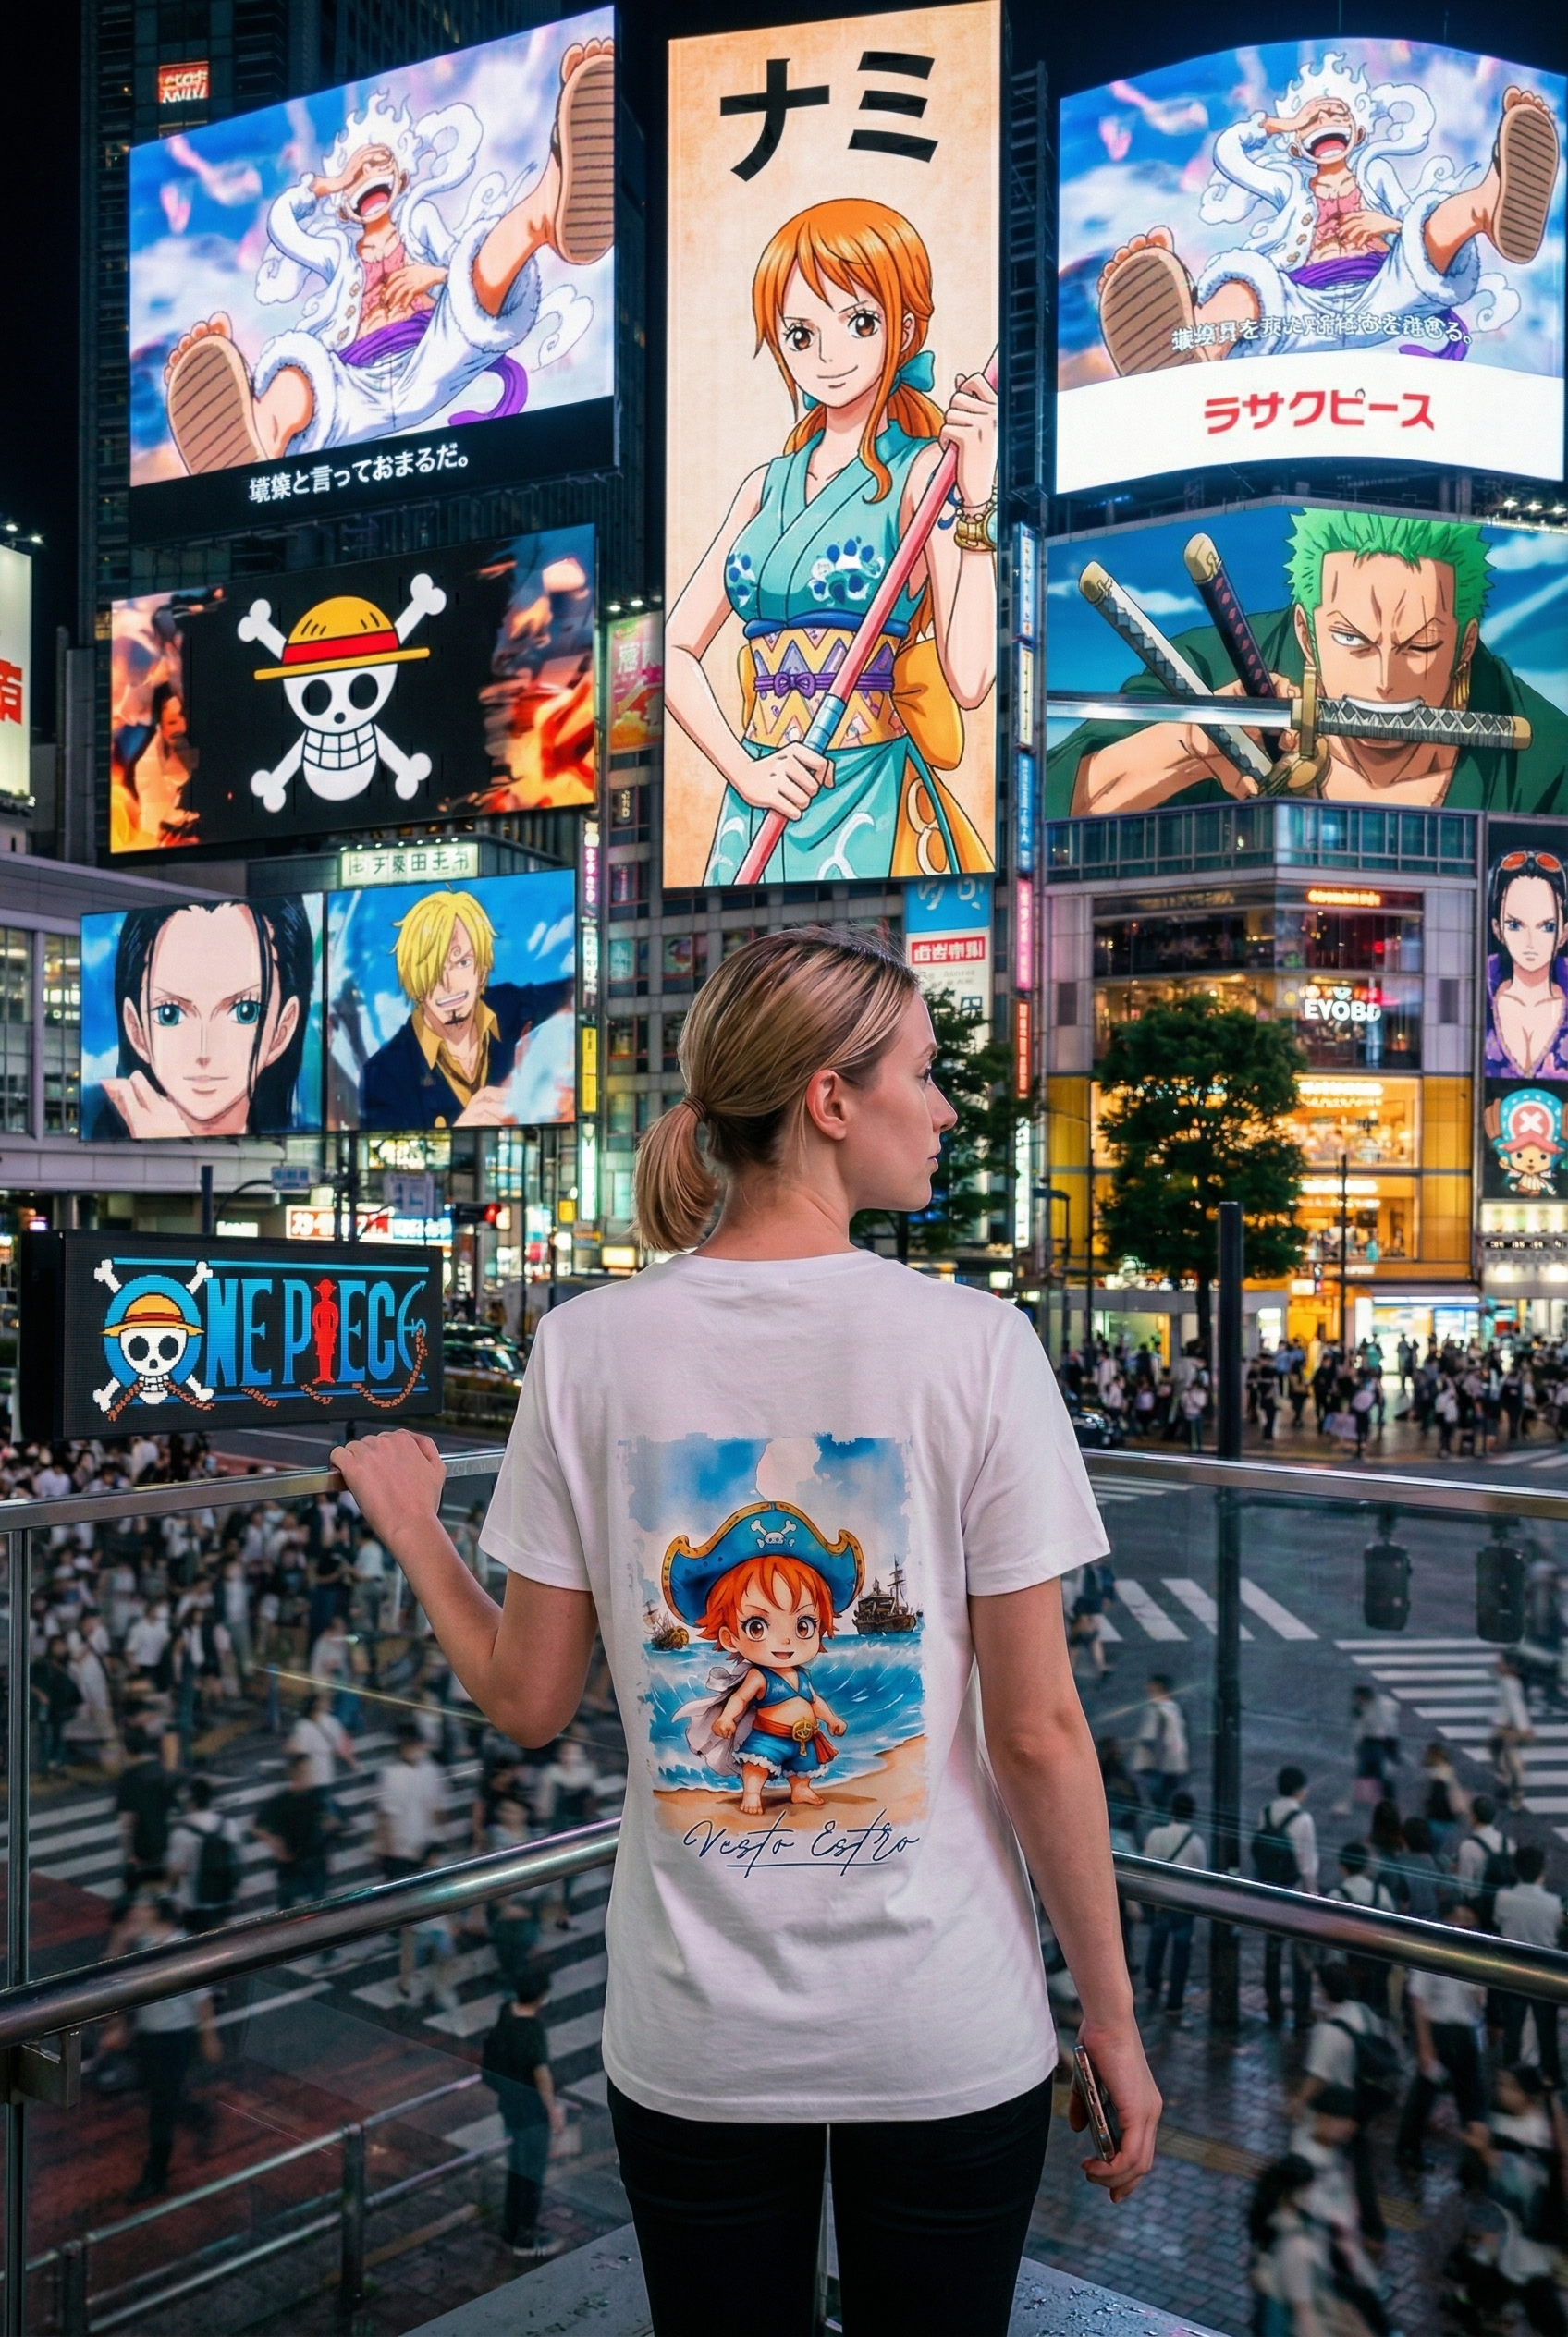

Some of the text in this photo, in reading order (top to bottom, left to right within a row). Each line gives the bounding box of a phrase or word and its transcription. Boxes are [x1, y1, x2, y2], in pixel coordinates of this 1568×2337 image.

[720, 51, 938, 182] ナミ
[1204, 388, 1436, 434] ラサクピース
[683, 1807, 920, 1878] Vesto Estro
